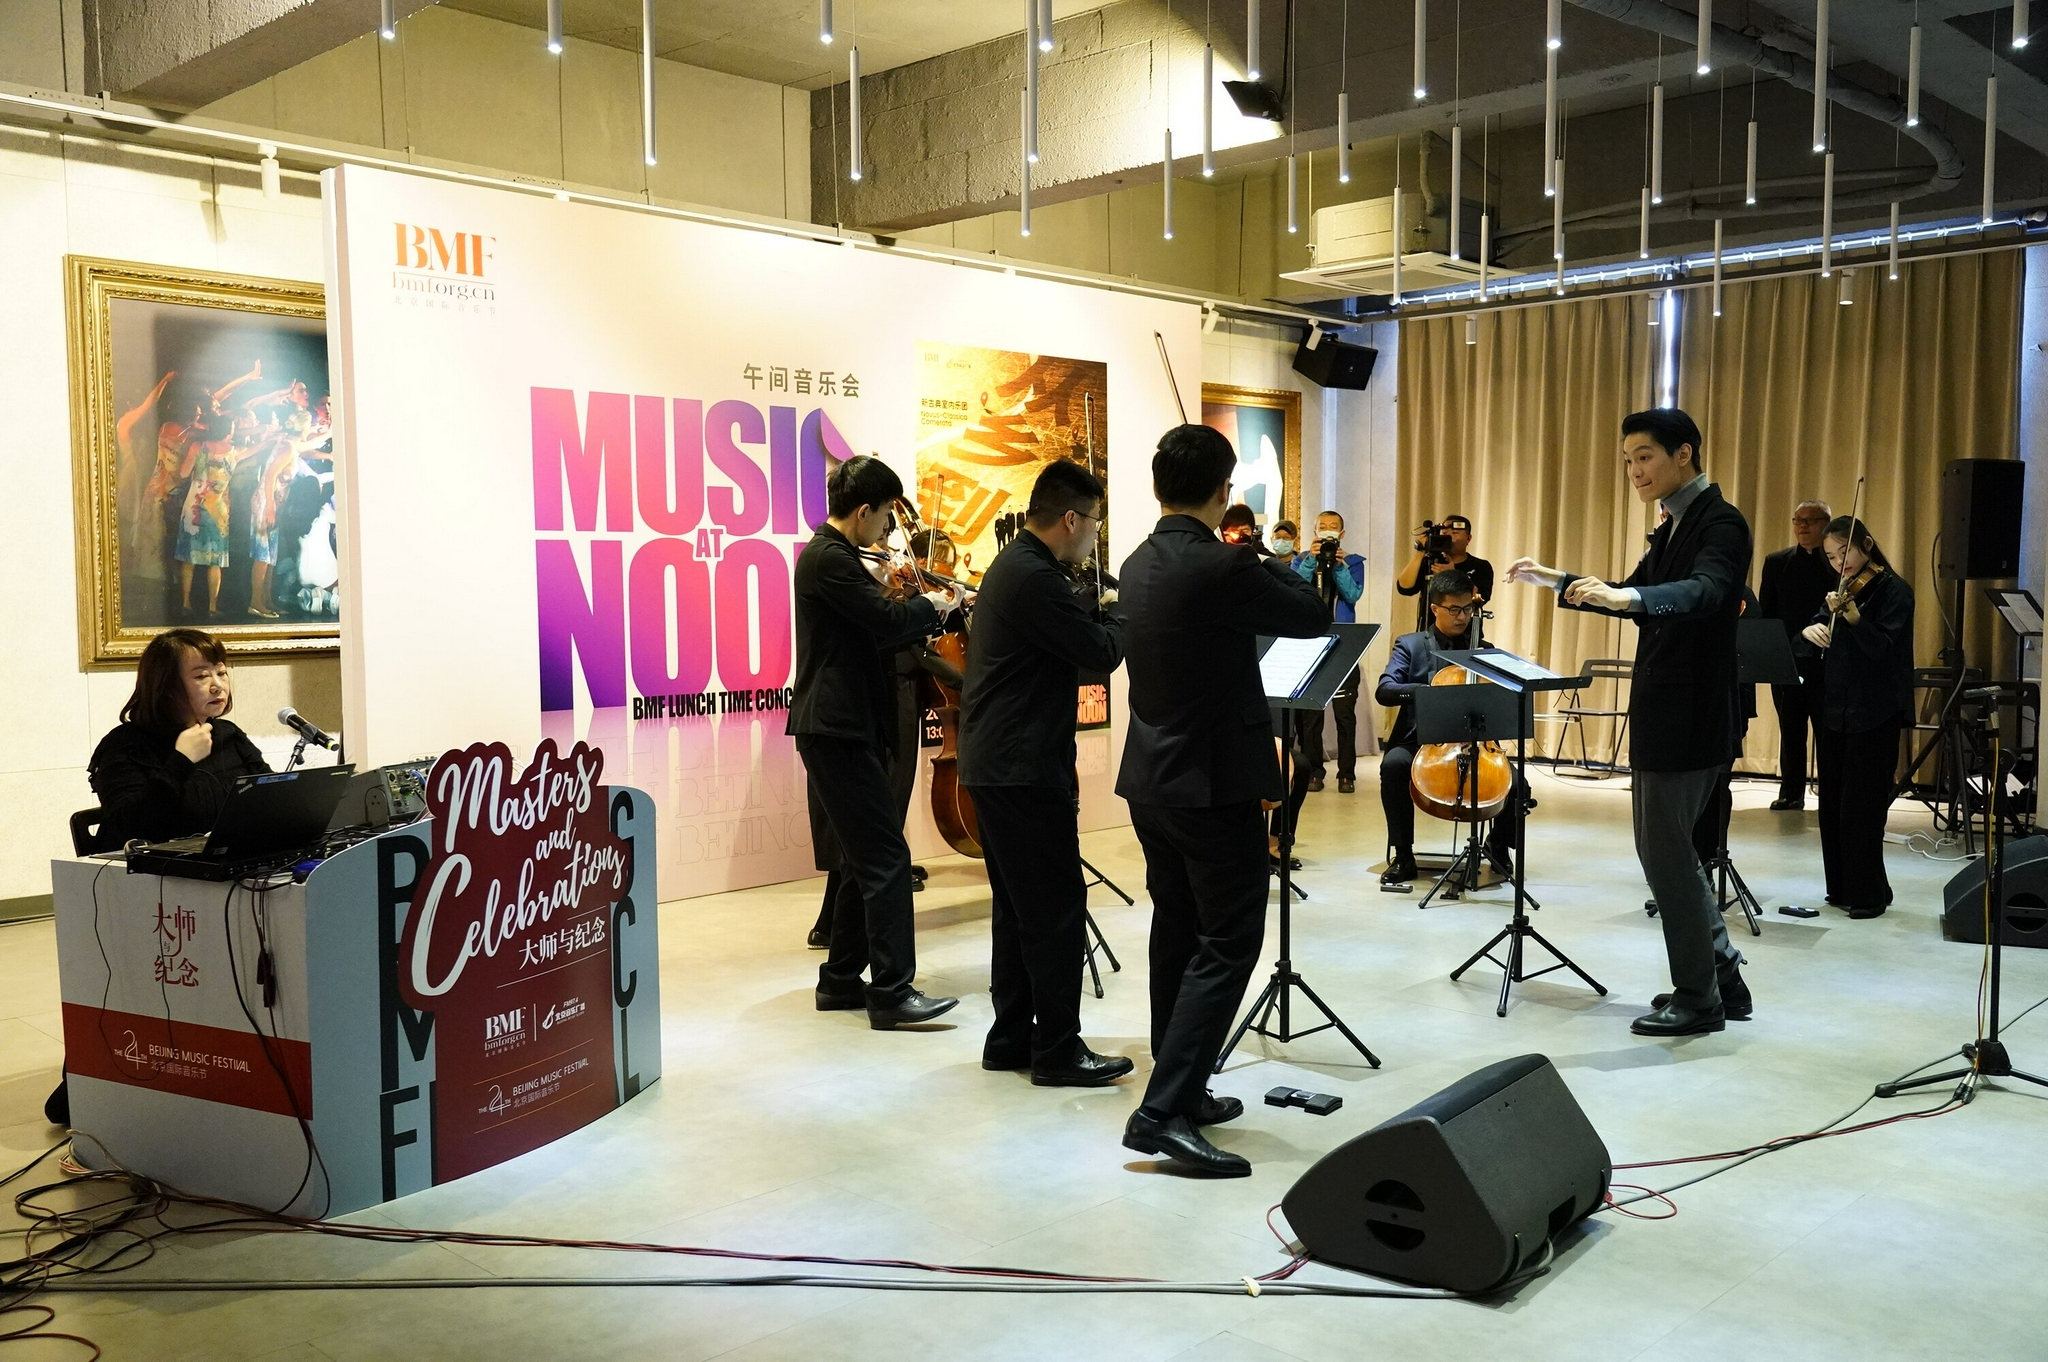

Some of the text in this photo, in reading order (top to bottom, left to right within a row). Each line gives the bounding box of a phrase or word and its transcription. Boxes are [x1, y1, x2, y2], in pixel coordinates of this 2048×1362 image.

[393, 222, 496, 277] BMF
[393, 271, 495, 301] bmf.org.cn
[743, 363, 860, 398] 午间音乐会
[696, 528, 723, 558] AT
[535, 537, 808, 712] NOO
[632, 686, 794, 720] BMF LUNCH TIME CONC
[437, 751, 598, 853] Masters
[535, 807, 577, 861] and
[152, 902, 196, 958] 大师
[411, 839, 626, 997] Celebrations
[518, 916, 607, 971] 大师与纪念
[154, 954, 199, 987] 纪念
[485, 1006, 527, 1040] BMF
[149, 1044, 180, 1060] BEIJING
[181, 1050, 210, 1066] MUSIC
[212, 1055, 252, 1073] FESTIVAL
[151, 1060, 208, 1079] 北京国际音乐节
[512, 1078, 539, 1097] BEIJING
[540, 1068, 563, 1084] MUSIC
[563, 1057, 590, 1076] FESTIVAL
